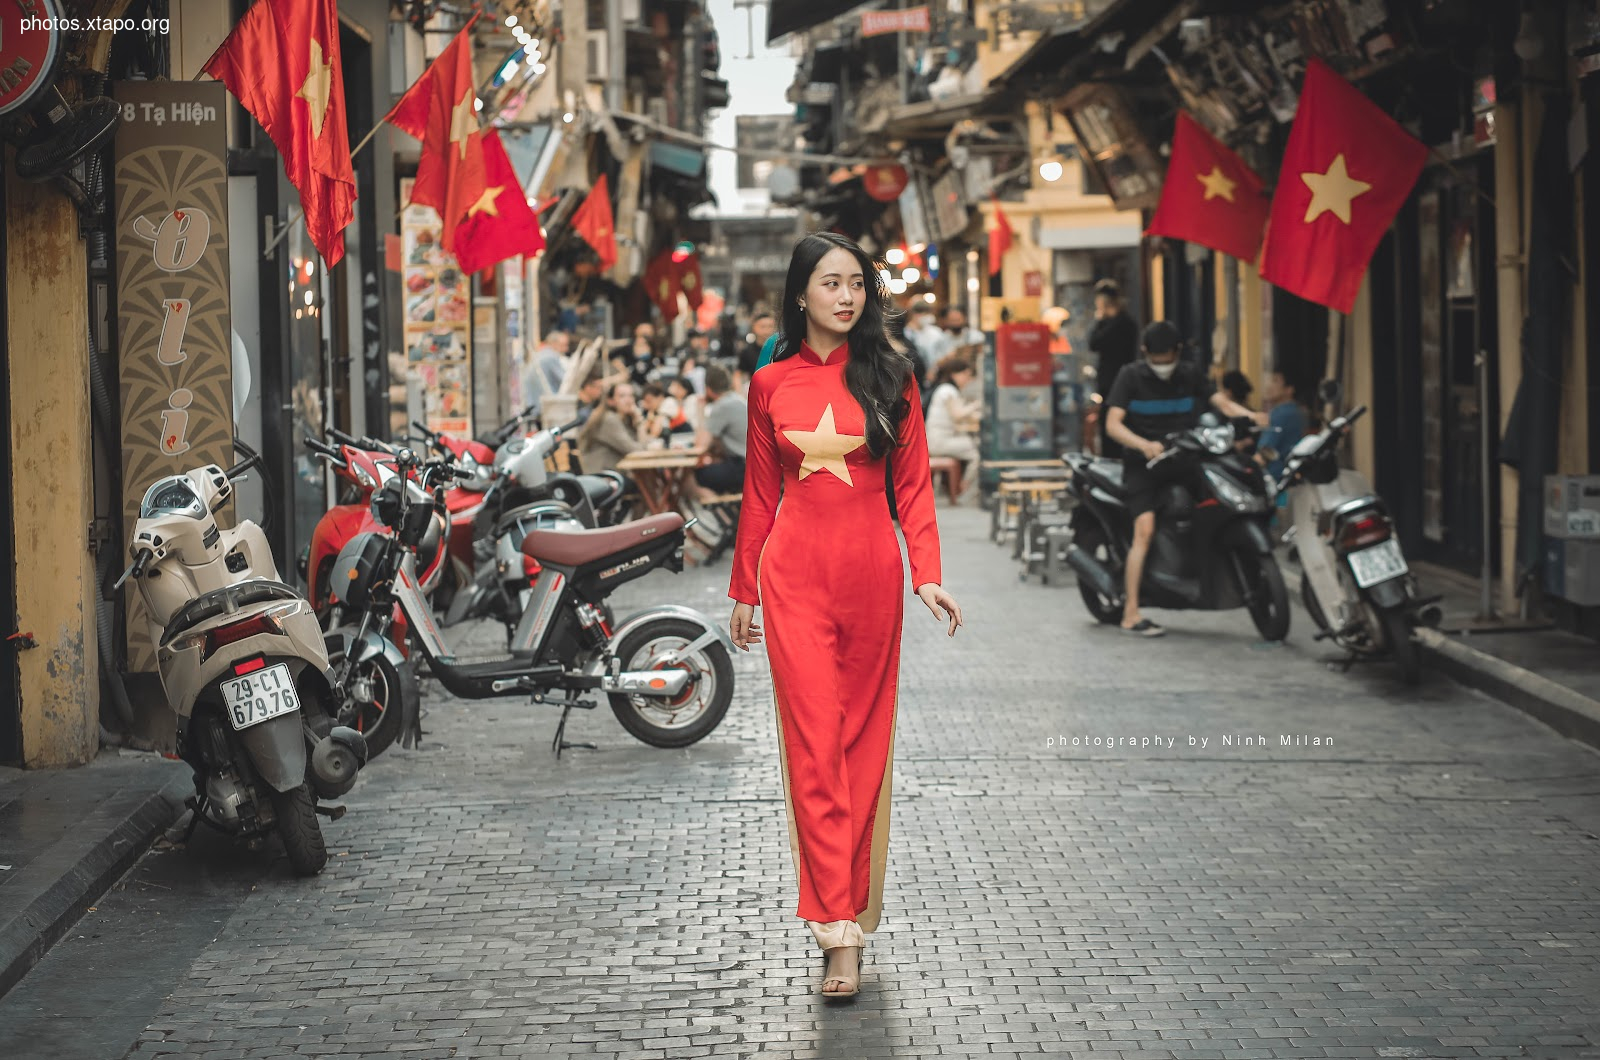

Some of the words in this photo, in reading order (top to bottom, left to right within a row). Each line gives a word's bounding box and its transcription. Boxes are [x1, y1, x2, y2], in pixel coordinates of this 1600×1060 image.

[140, 102, 166, 126] Tạ
[171, 102, 216, 126] Hiện
[231, 669, 281, 702] 29-C1
[233, 688, 295, 725] 679.76
